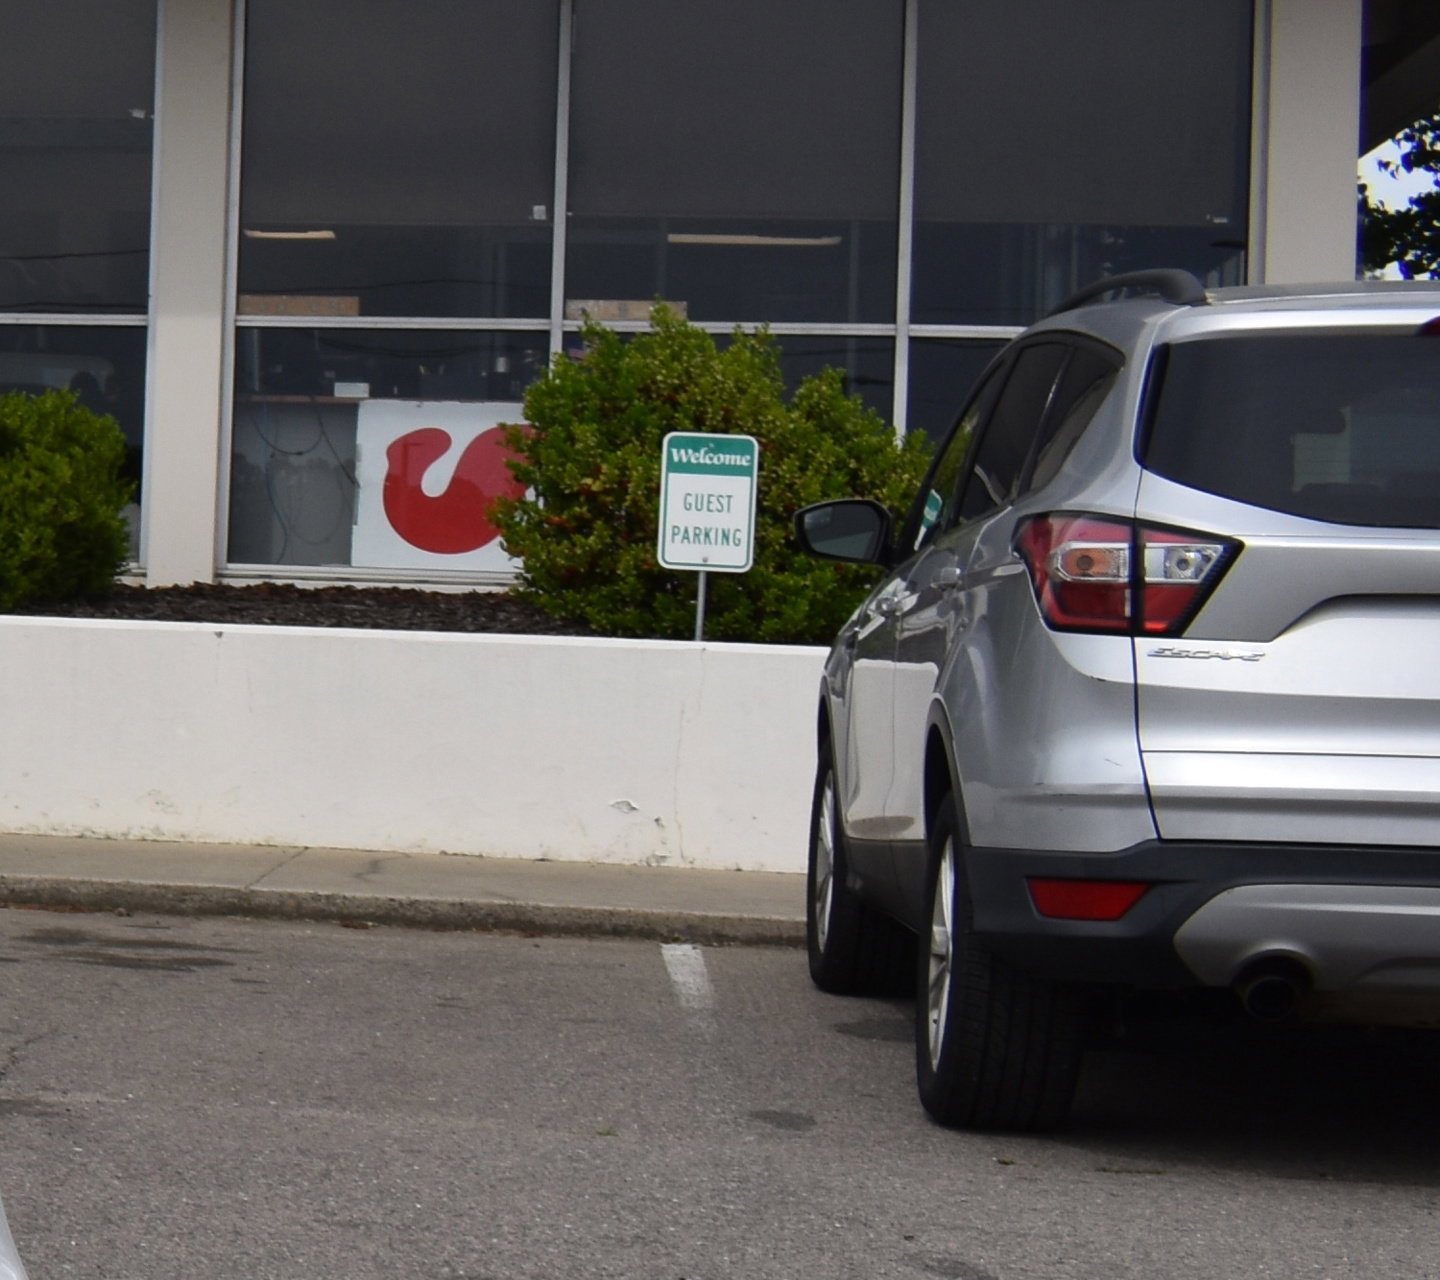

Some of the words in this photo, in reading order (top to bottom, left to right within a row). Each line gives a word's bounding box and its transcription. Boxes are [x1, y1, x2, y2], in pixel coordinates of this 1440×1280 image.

[670, 446, 751, 467] Welcome
[683, 492, 734, 513] GUEST
[670, 524, 743, 547] PARKING
